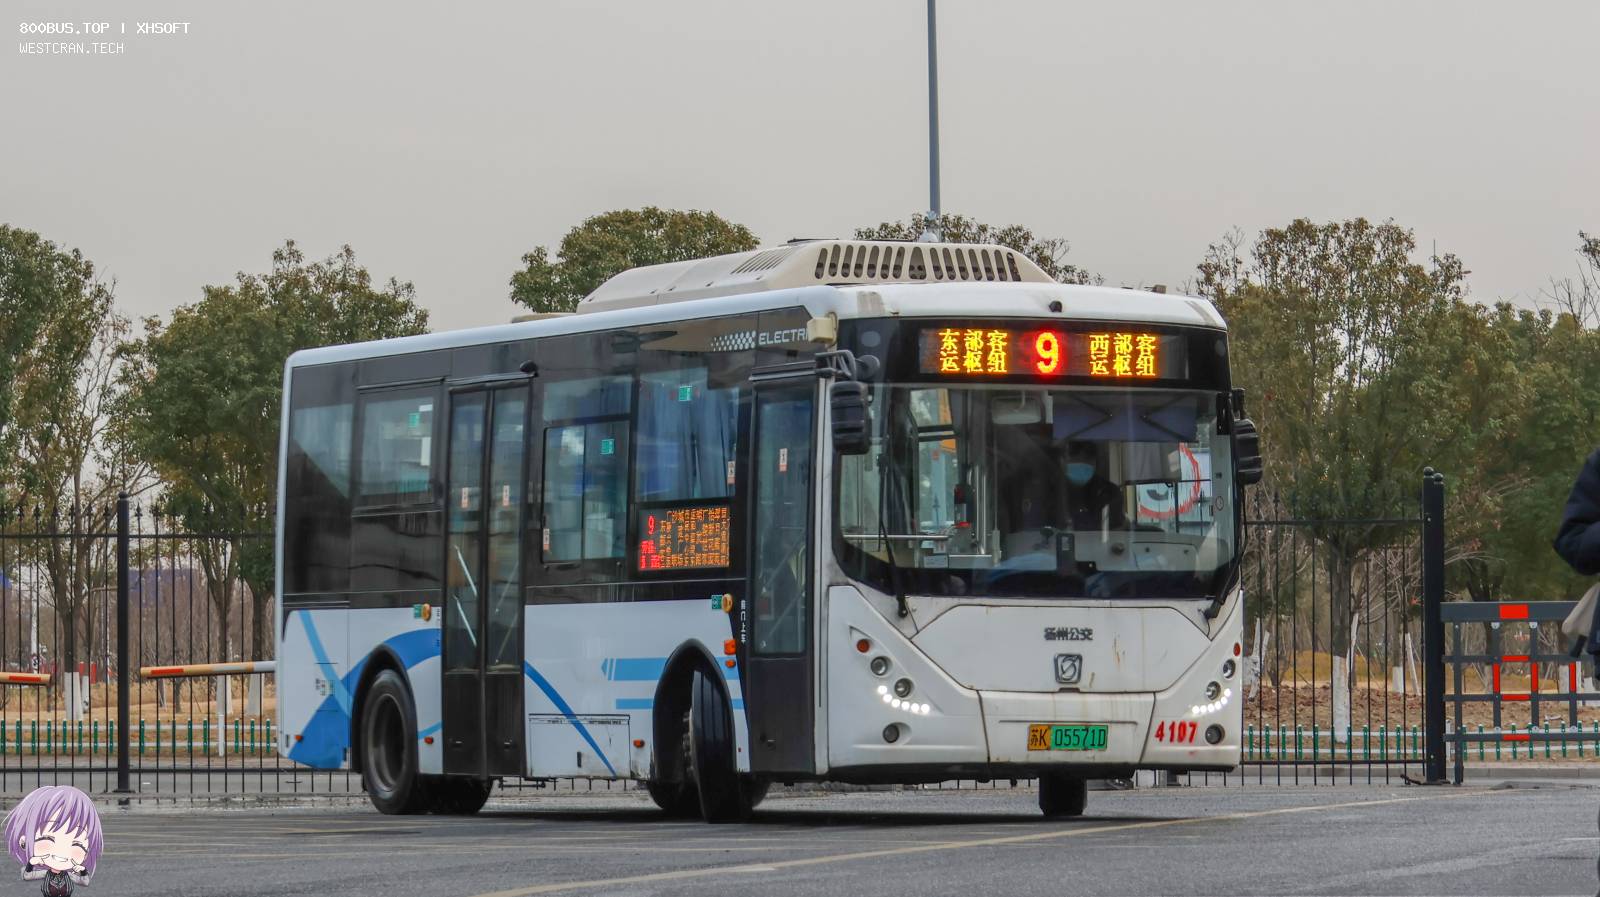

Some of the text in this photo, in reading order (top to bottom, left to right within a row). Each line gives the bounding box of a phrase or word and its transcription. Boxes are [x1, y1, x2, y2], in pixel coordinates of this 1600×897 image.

[939, 328, 1008, 352] 东部客
[1089, 333, 1156, 356] 西部客
[1035, 332, 1059, 373] 9
[648, 515, 655, 535] 9
[1154, 720, 1197, 743] 4107
